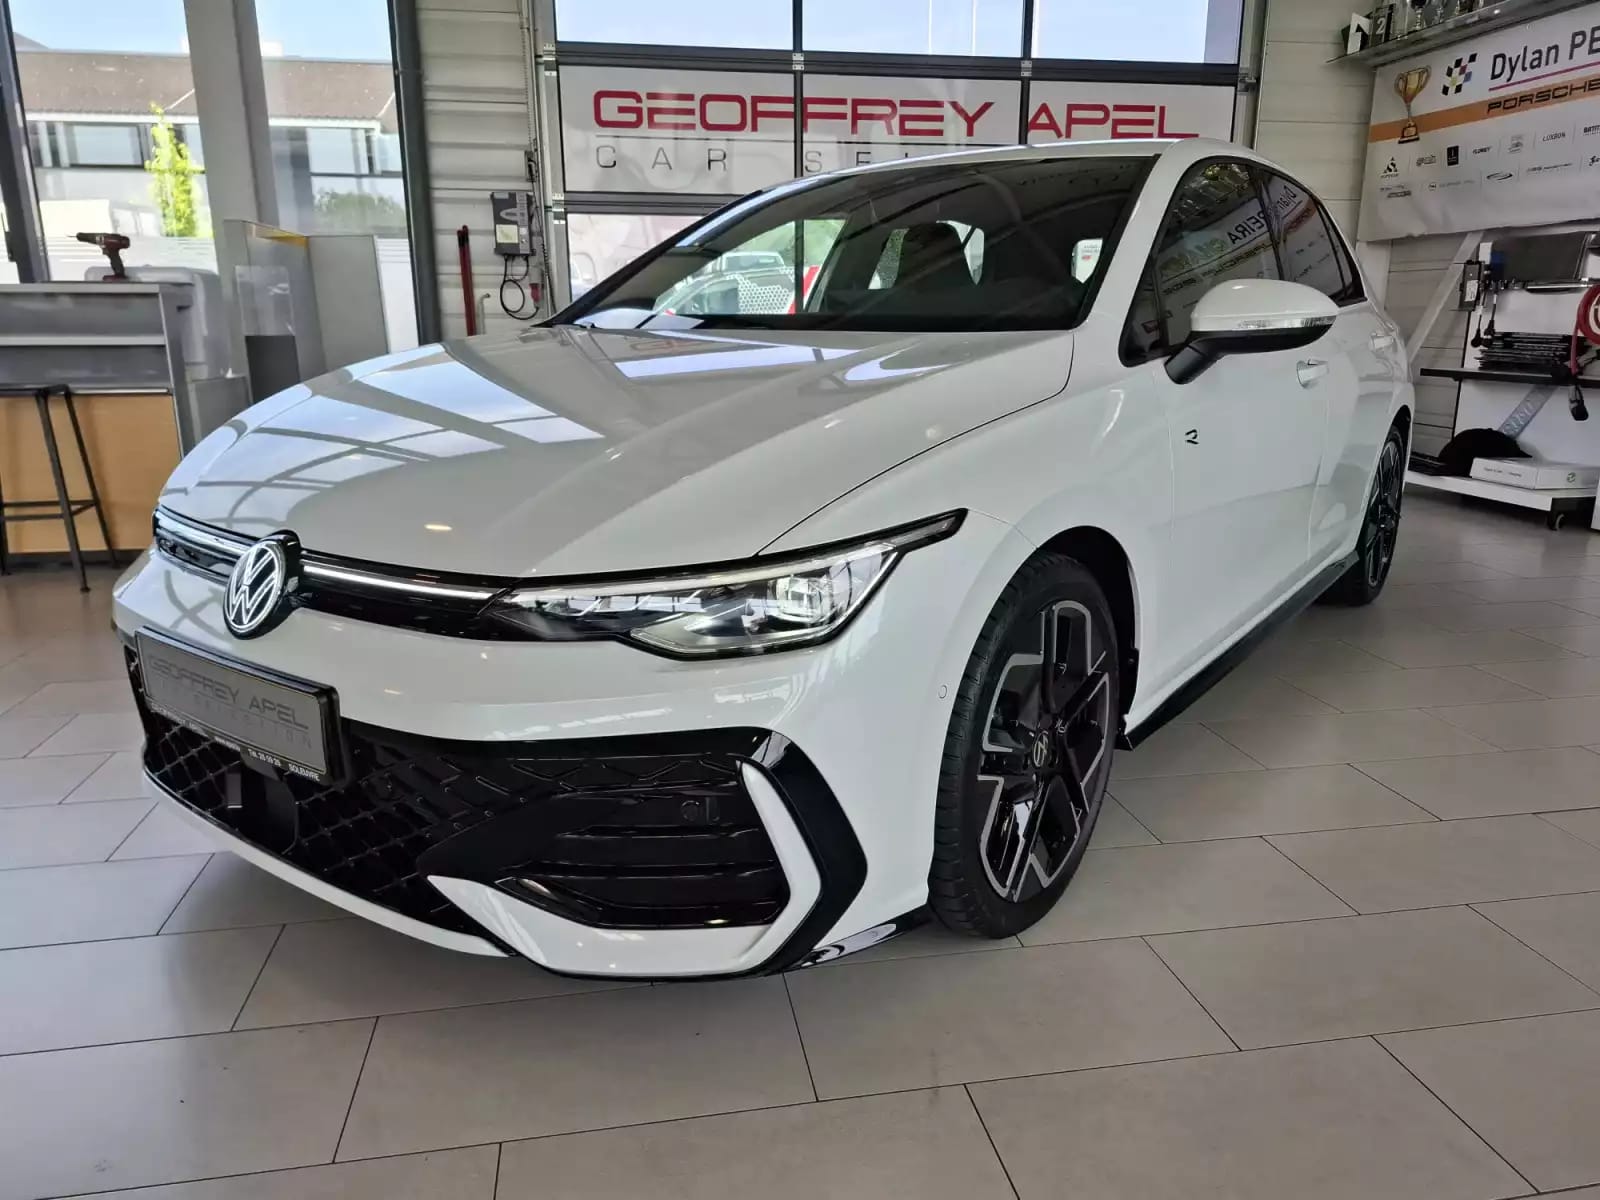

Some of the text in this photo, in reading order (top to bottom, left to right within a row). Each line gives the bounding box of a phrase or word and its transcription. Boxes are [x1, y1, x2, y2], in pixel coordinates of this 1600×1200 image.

[1490, 44, 1559, 82] Dylan
[1487, 78, 1600, 114] PORSCHE
[593, 90, 1199, 139] GEOFFREY APEL
[596, 145, 727, 172] CAR
[249, 696, 310, 731] APEL
